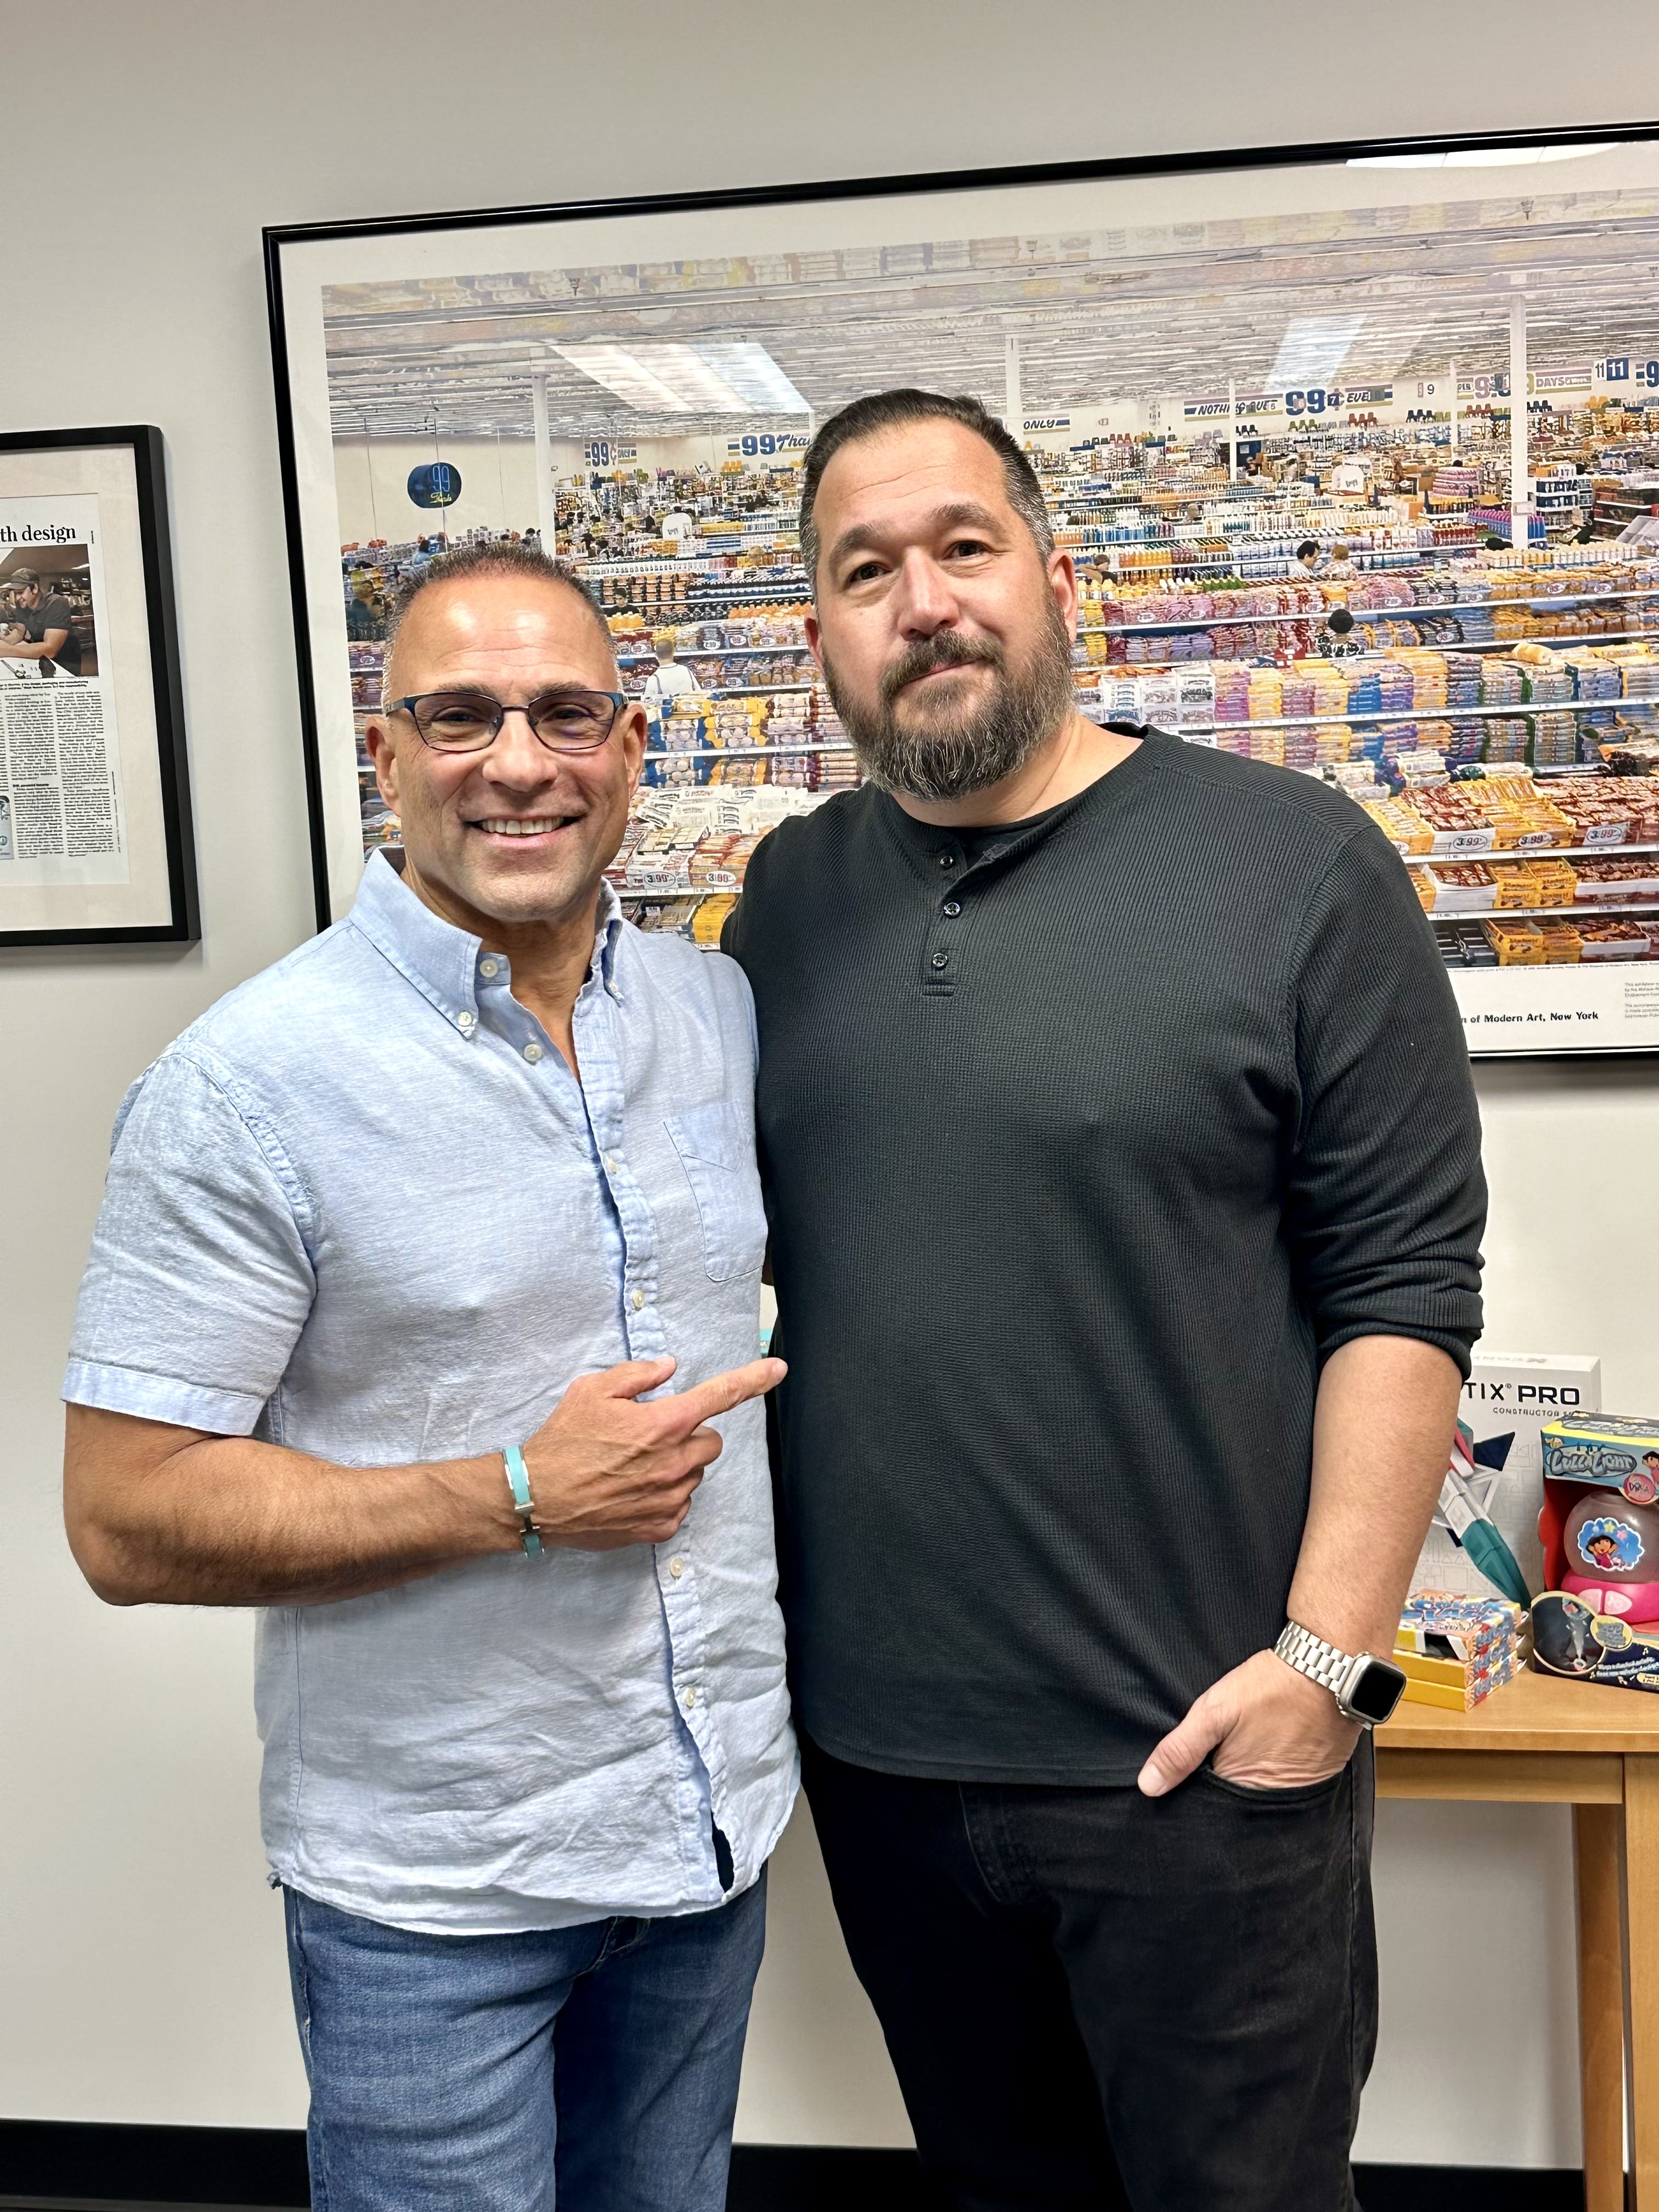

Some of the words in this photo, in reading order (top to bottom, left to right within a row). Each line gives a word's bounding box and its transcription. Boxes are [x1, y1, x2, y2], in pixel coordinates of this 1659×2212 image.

[1609, 362, 1624, 377] 11
[1427, 384, 1435, 394] 9
[1024, 419, 1055, 430] ONLY
[742, 434, 776, 456] 99
[0, 525, 18, 542] th
[22, 524, 76, 544] design
[1470, 1015, 1480, 1023] of
[1484, 1014, 1522, 1023] Modern
[1526, 1013, 1546, 1022] Art,
[1550, 1013, 1572, 1021] New
[1576, 1012, 1599, 1020] York
[1518, 1385, 1579, 1406] PRO
